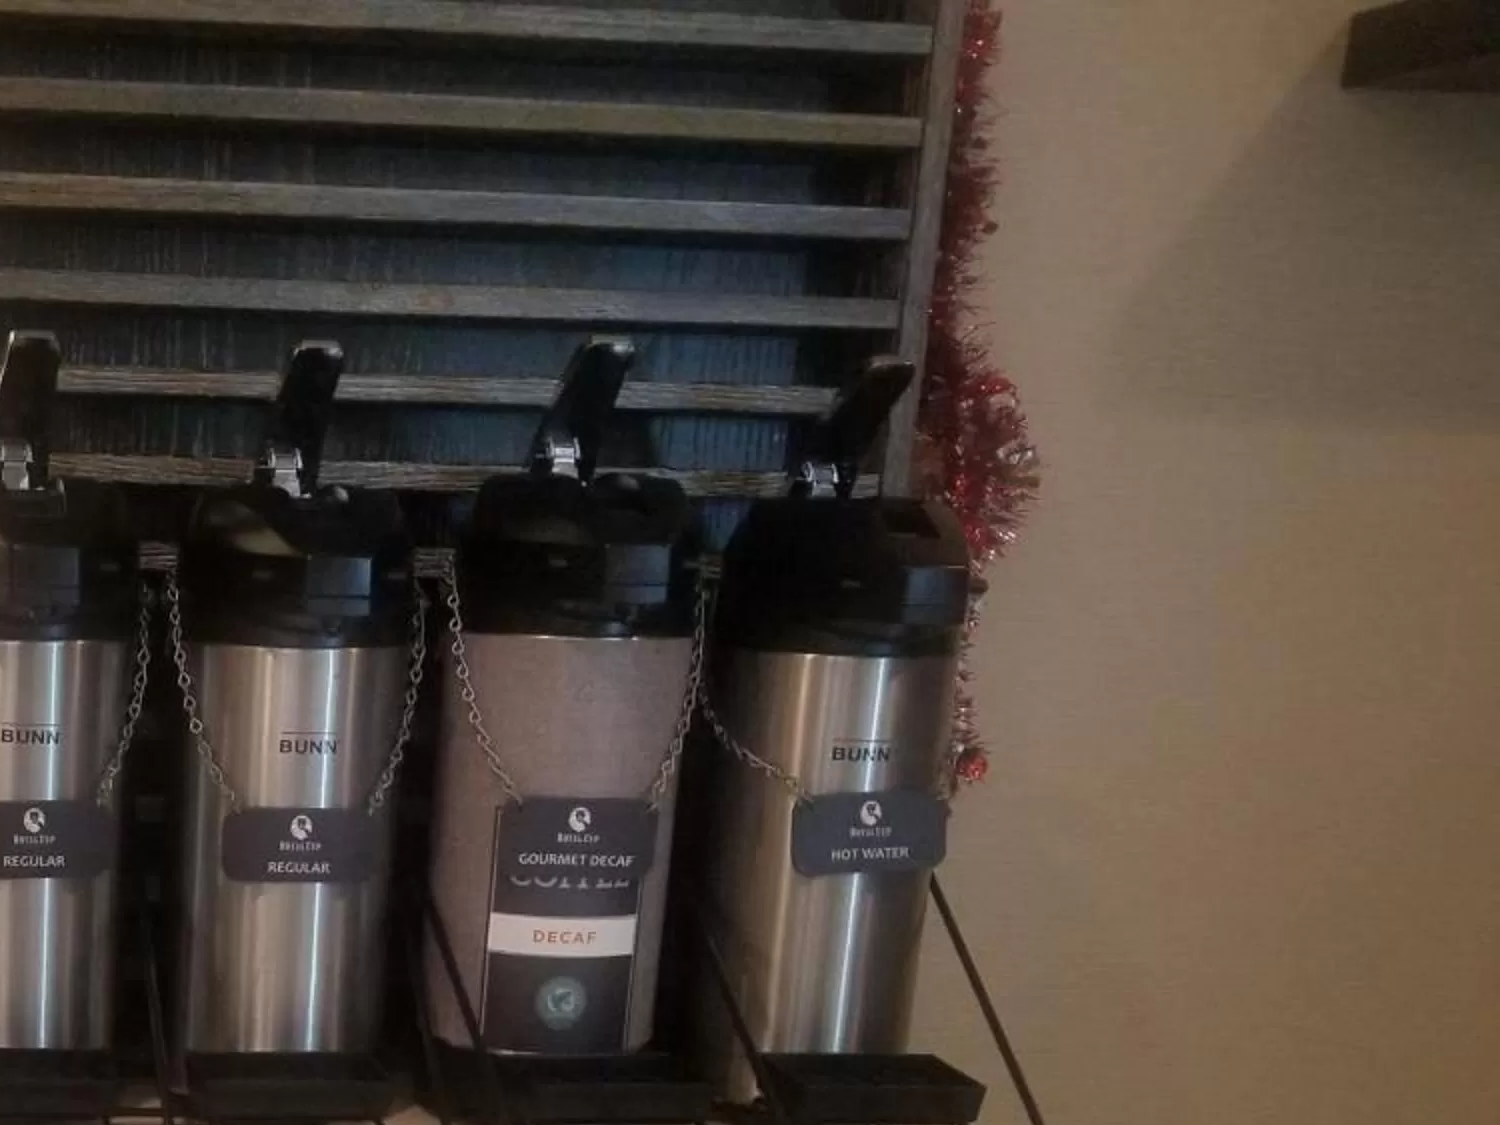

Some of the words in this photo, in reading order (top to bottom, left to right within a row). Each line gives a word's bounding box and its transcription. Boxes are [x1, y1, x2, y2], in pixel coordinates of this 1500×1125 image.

[1, 728, 60, 745] BUNN
[279, 739, 337, 754] BUNN
[831, 746, 891, 762] BUNN
[3, 855, 66, 869] REGULAR
[518, 852, 588, 866] GOURMET
[589, 855, 636, 868] DECAF
[831, 848, 859, 862] HOT
[861, 846, 910, 860] WATER
[267, 861, 332, 874] REGULAR
[532, 929, 597, 945] DECAF
